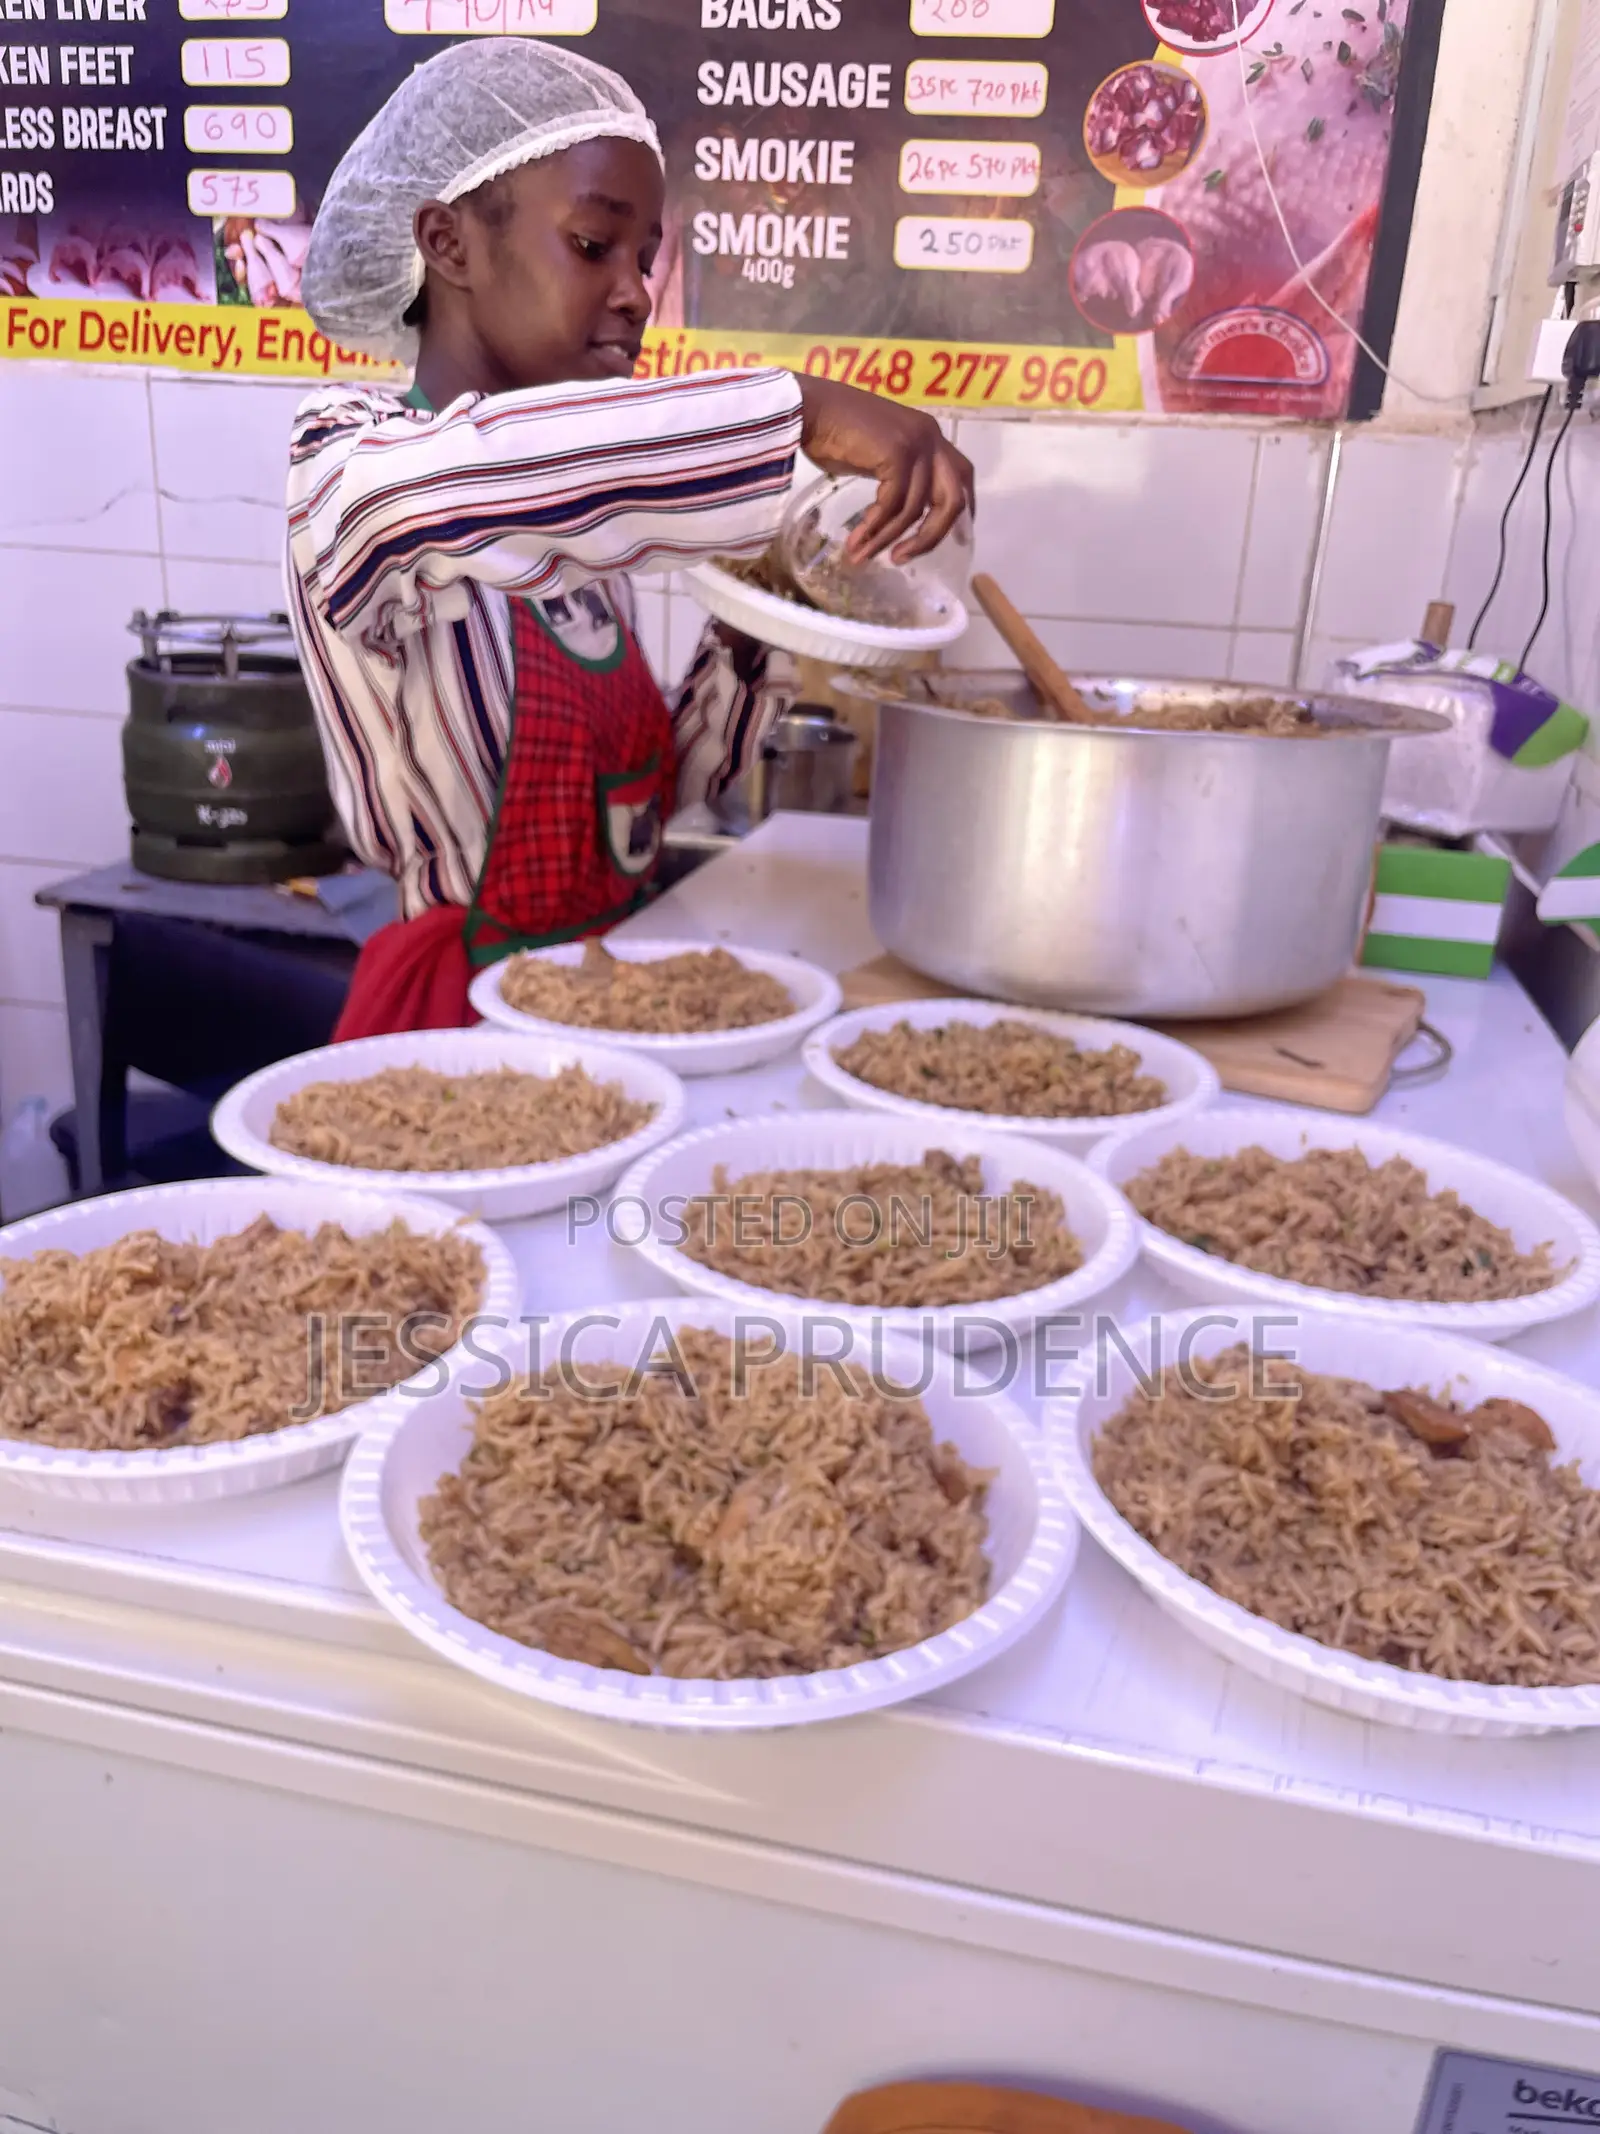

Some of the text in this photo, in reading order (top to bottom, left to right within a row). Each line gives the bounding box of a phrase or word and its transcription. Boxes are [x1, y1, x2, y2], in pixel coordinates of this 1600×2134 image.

[701, 0, 842, 31] BACKS
[59, 45, 134, 85] FEET
[202, 46, 265, 79] 115
[697, 60, 892, 109] SAUSAGE
[62, 106, 167, 150] BREAST
[204, 111, 277, 140] 690
[694, 136, 855, 184] SMOKIE
[0, 171, 54, 214] RDS
[201, 174, 260, 207] 575
[692, 210, 850, 260] SMOKIE
[919, 228, 983, 255] 250
[741, 258, 796, 289] 400g
[7, 307, 66, 349] For
[78, 307, 243, 369] Delivery,
[804, 345, 914, 395] 0748
[924, 351, 1011, 400] 277
[1018, 356, 1107, 406] 960
